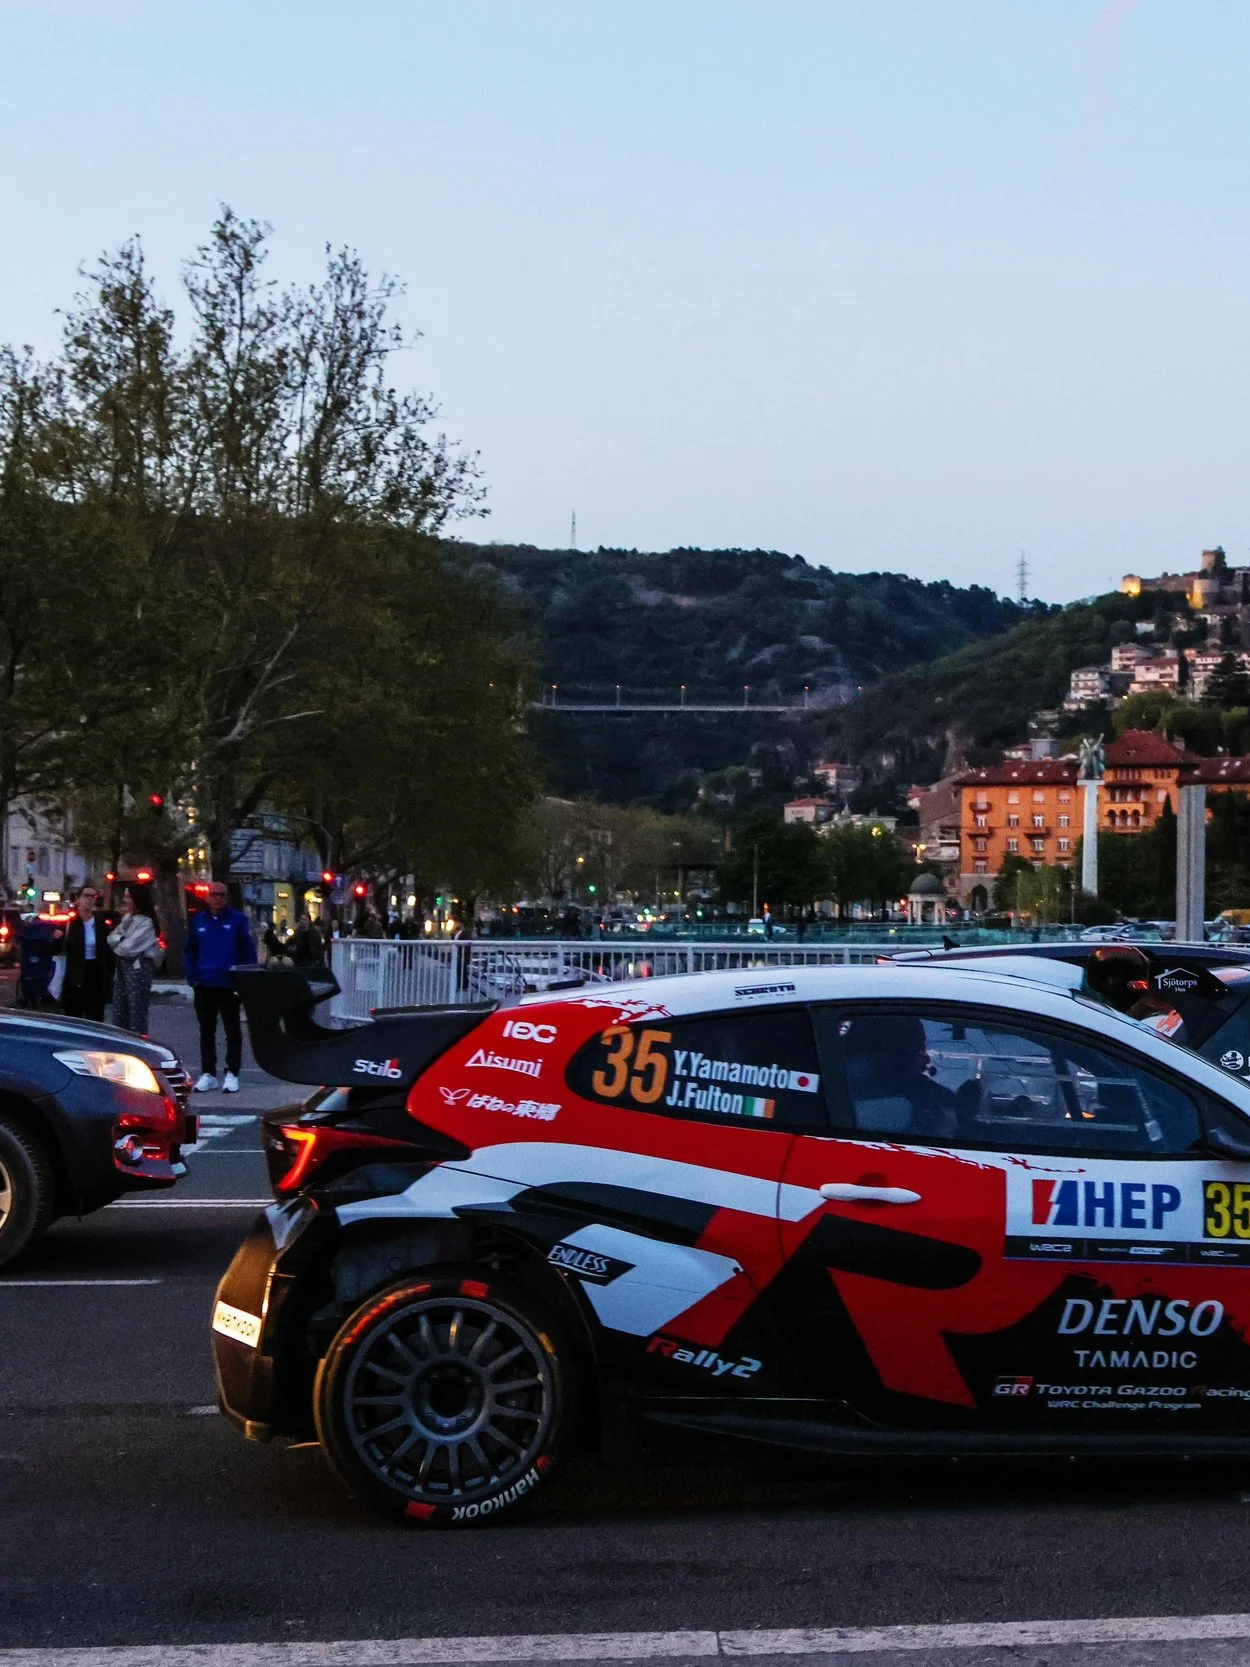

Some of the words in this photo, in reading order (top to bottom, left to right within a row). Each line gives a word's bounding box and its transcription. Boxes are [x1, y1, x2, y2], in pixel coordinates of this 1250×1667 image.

[1162, 975, 1198, 988] Sjötorps
[352, 1058, 402, 1079] Stilo
[465, 1048, 544, 1078] Aisumi
[592, 1025, 672, 1104] 35
[673, 1049, 789, 1089] Y.Yamamoto
[665, 1080, 744, 1115] J.Fulton
[1084, 1181, 1182, 1230] HEP
[548, 1245, 611, 1273] ENDLESS
[1057, 1299, 1225, 1337] DENSO
[646, 1337, 762, 1378] Rally2
[1074, 1350, 1198, 1369] TAMADIC
[994, 1383, 1030, 1395] GR
[1035, 1384, 1112, 1396] TOYOTA
[1117, 1385, 1187, 1396] GAZOO
[1082, 1400, 1145, 1411] Challenge
[1148, 1401, 1202, 1411] Program
